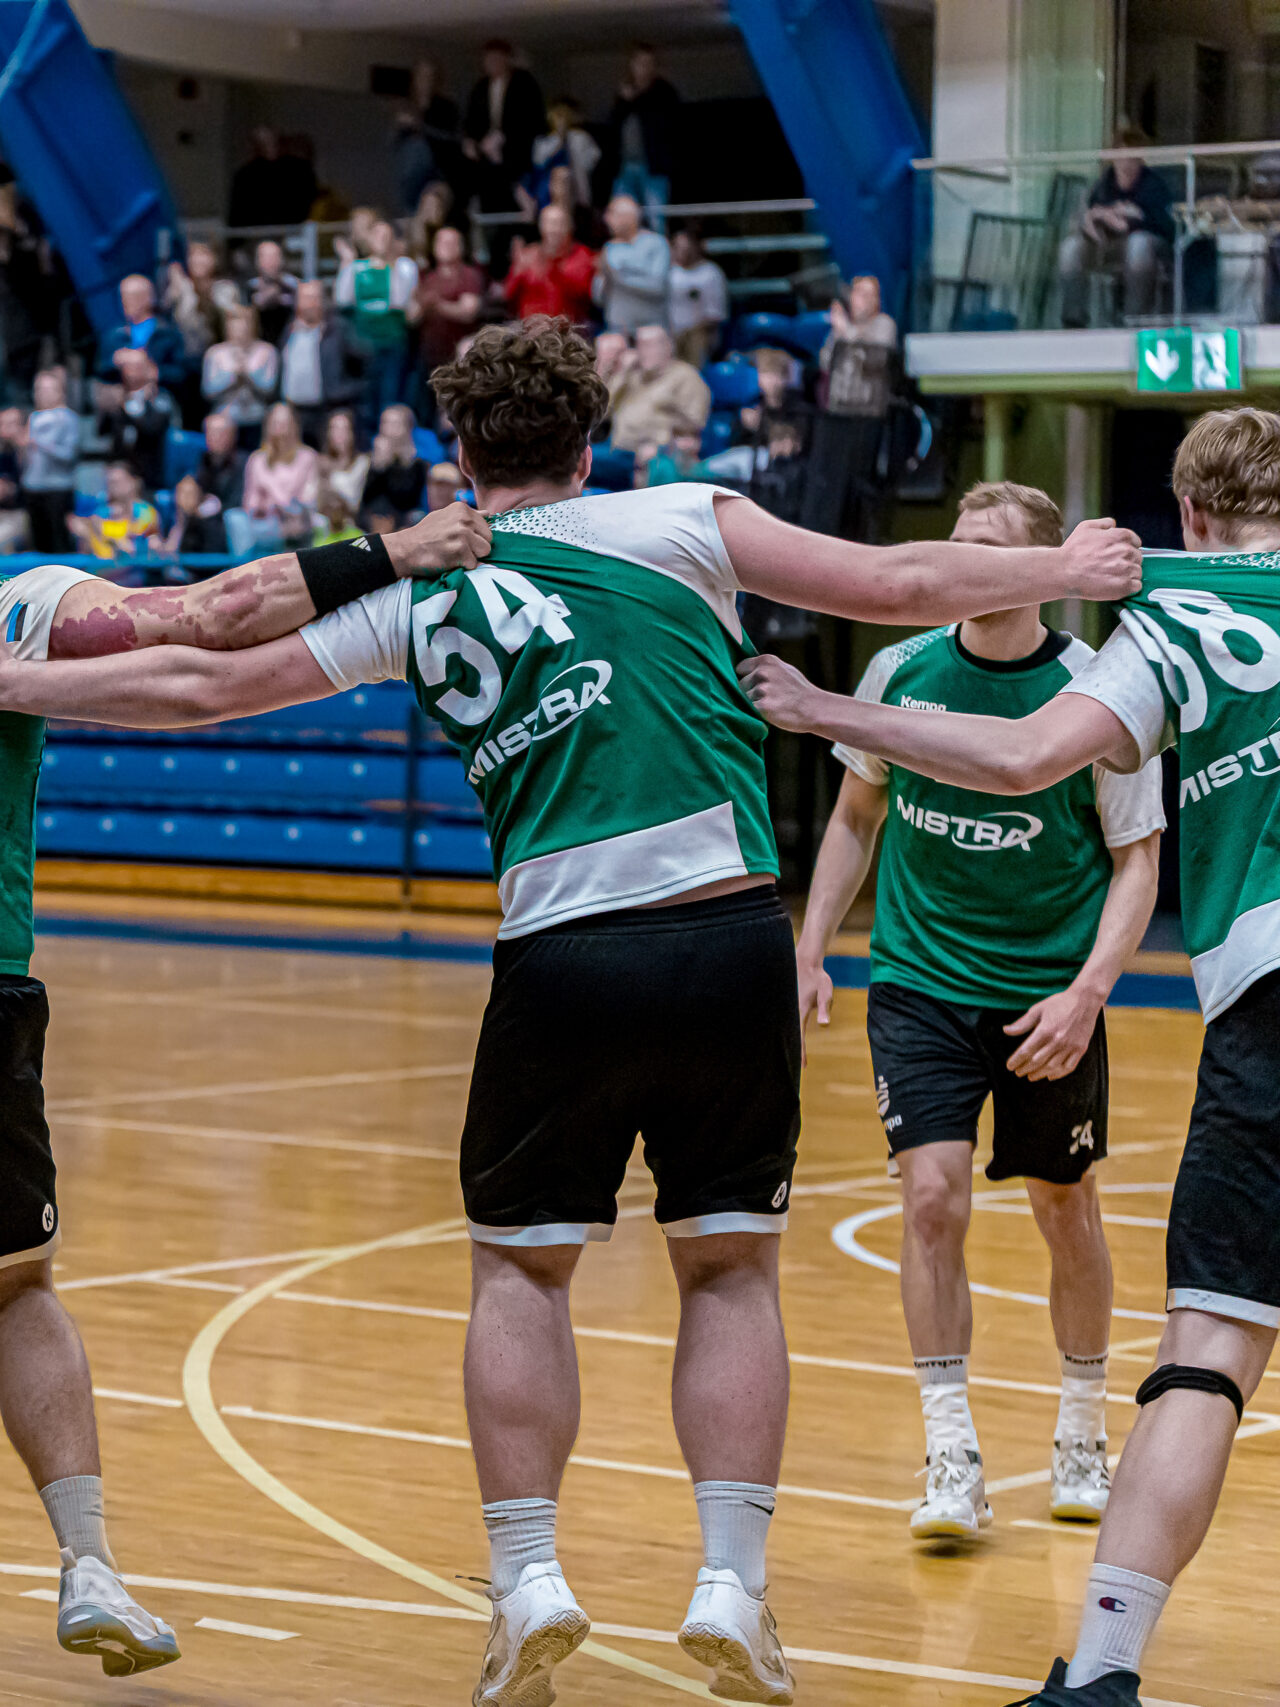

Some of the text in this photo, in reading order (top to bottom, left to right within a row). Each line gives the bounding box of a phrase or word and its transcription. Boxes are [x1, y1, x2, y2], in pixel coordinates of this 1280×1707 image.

[412, 564, 575, 726] 54
[469, 681, 612, 785] MISTRA
[897, 794, 1031, 852] MISTRA
